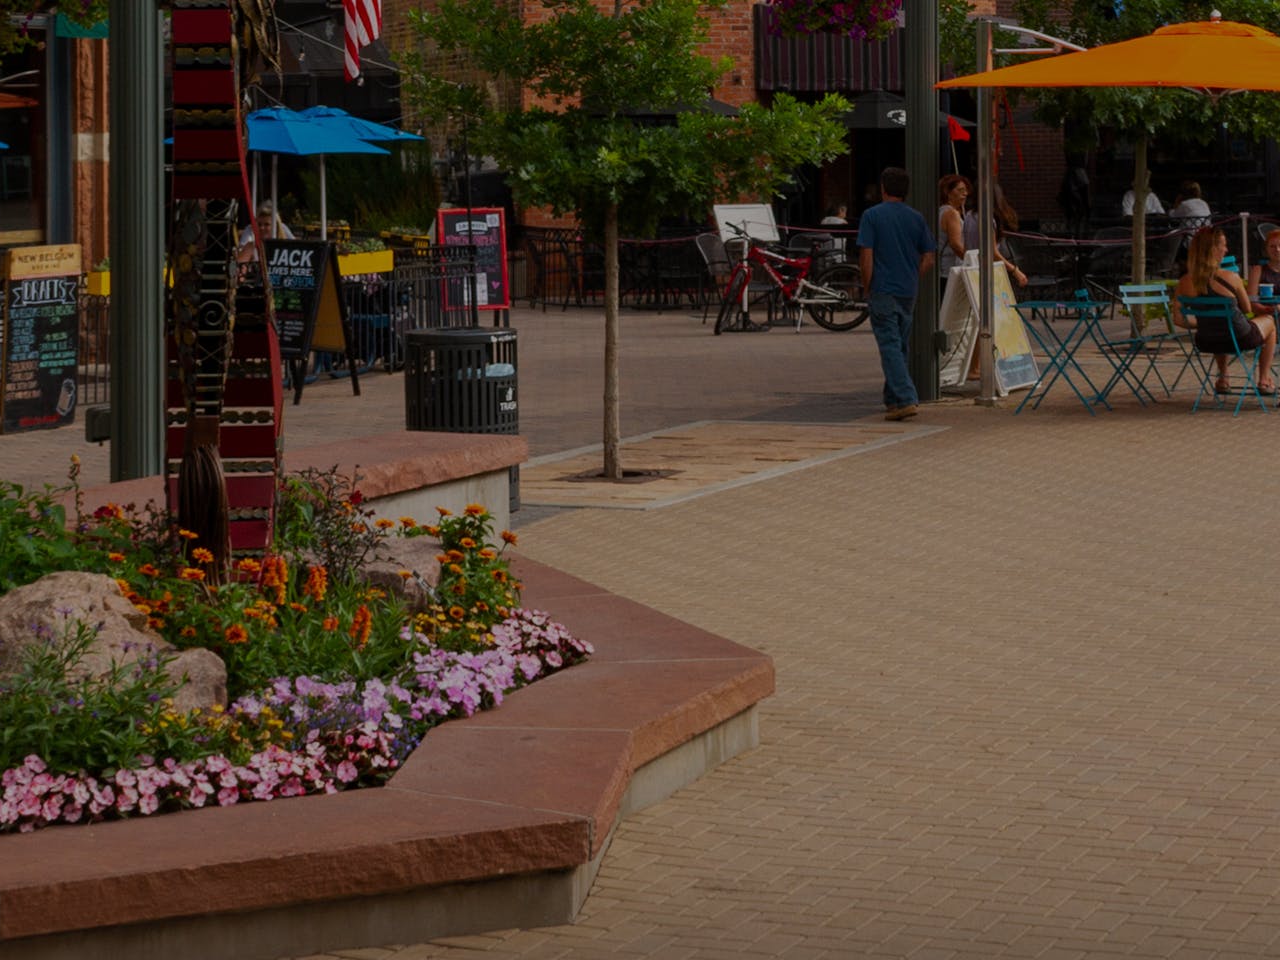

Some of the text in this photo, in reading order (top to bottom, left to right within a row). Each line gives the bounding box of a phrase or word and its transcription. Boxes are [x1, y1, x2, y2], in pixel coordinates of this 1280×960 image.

[18, 255, 36, 263] NEW
[269, 248, 314, 267] JACK
[23, 280, 66, 300] DRAFTS
